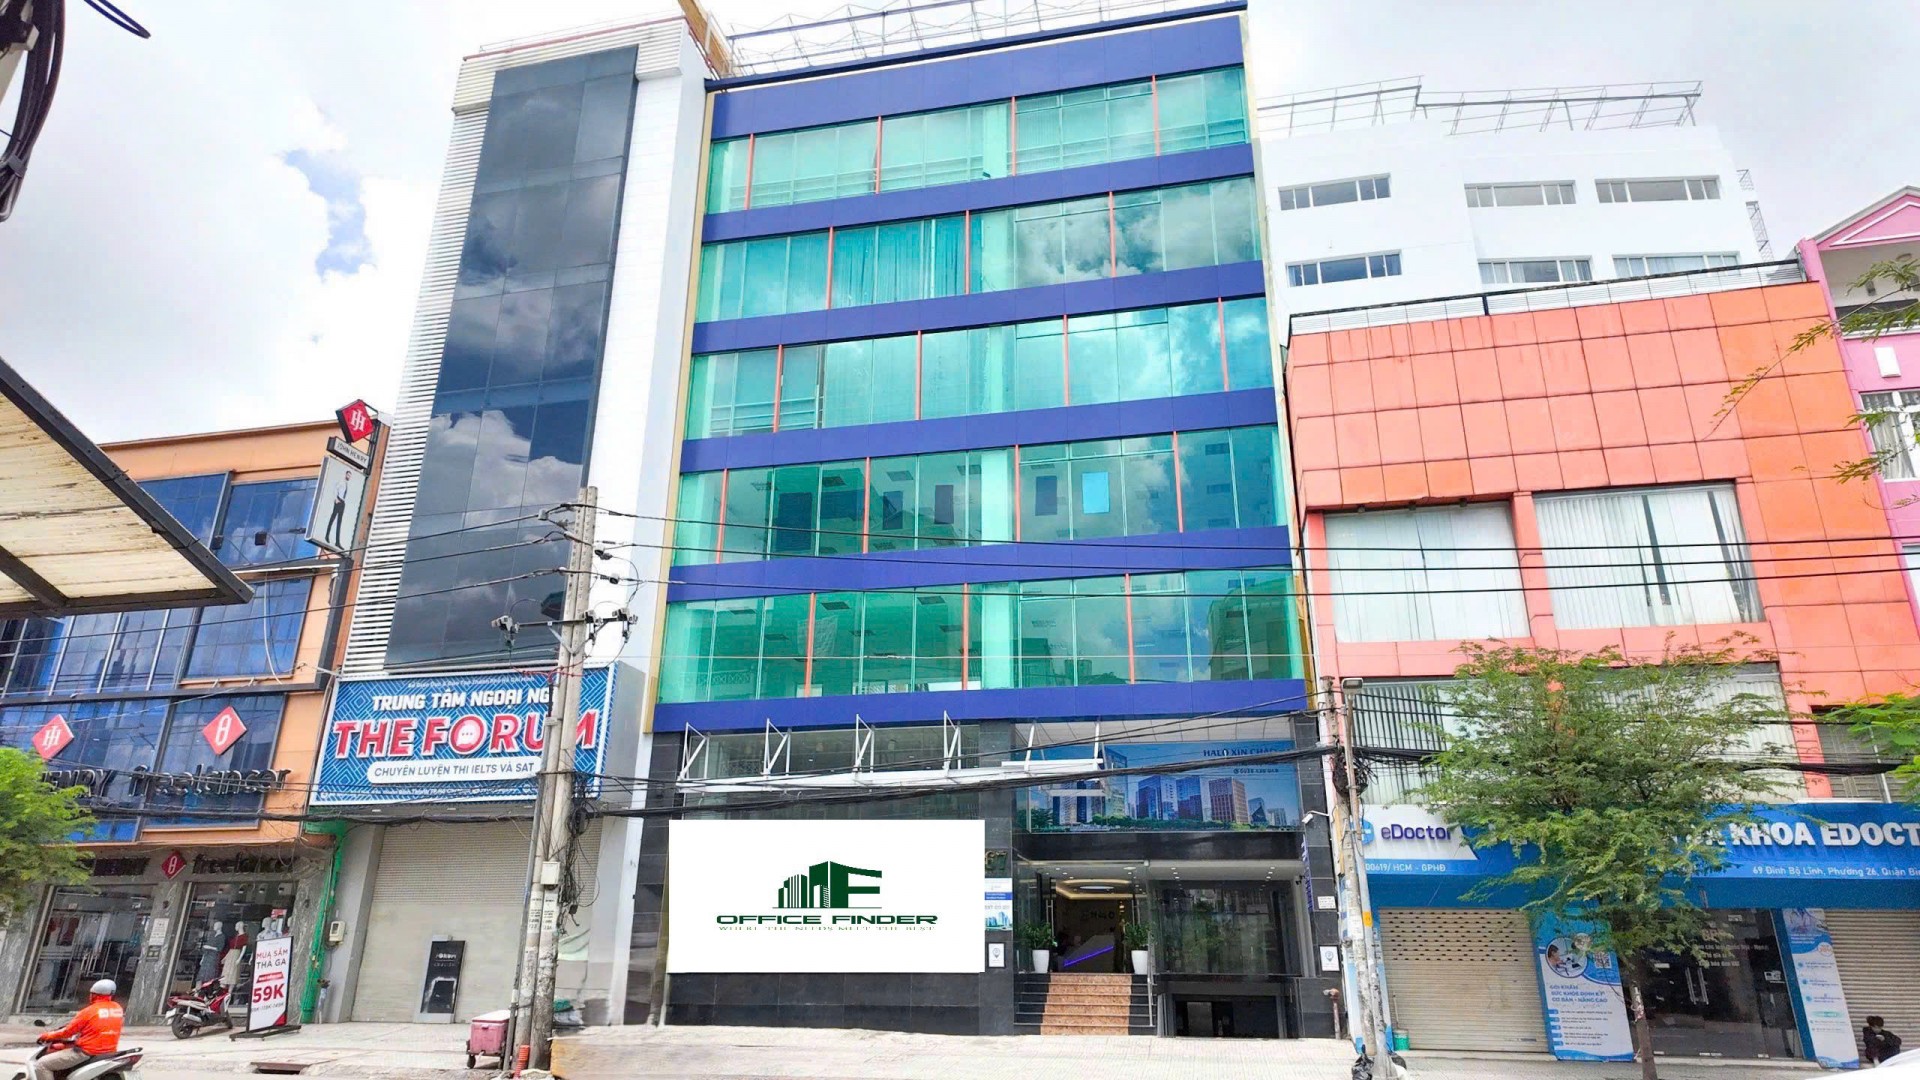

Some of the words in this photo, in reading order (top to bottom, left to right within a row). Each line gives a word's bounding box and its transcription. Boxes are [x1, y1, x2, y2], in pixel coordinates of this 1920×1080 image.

[372, 694, 426, 712] TRUNG
[431, 688, 467, 708] TÂM
[470, 688, 522, 709] NGOẠI
[527, 685, 559, 704] NG
[333, 717, 418, 759] THE
[1203, 748, 1229, 757] HALO
[1231, 748, 1248, 756] XIN
[374, 765, 415, 777] CHUYÊN
[418, 764, 449, 778] LUYỆN
[453, 765, 469, 775] THI
[471, 764, 497, 774] IELTS
[500, 762, 513, 772] VÀ
[515, 762, 535, 772] SAT
[41, 769, 115, 797] ENRY
[1729, 822, 1816, 847] KHOA
[1393, 864, 1413, 872] HCM
[1752, 866, 1763, 875] 69
[252, 983, 286, 1004] 59K
